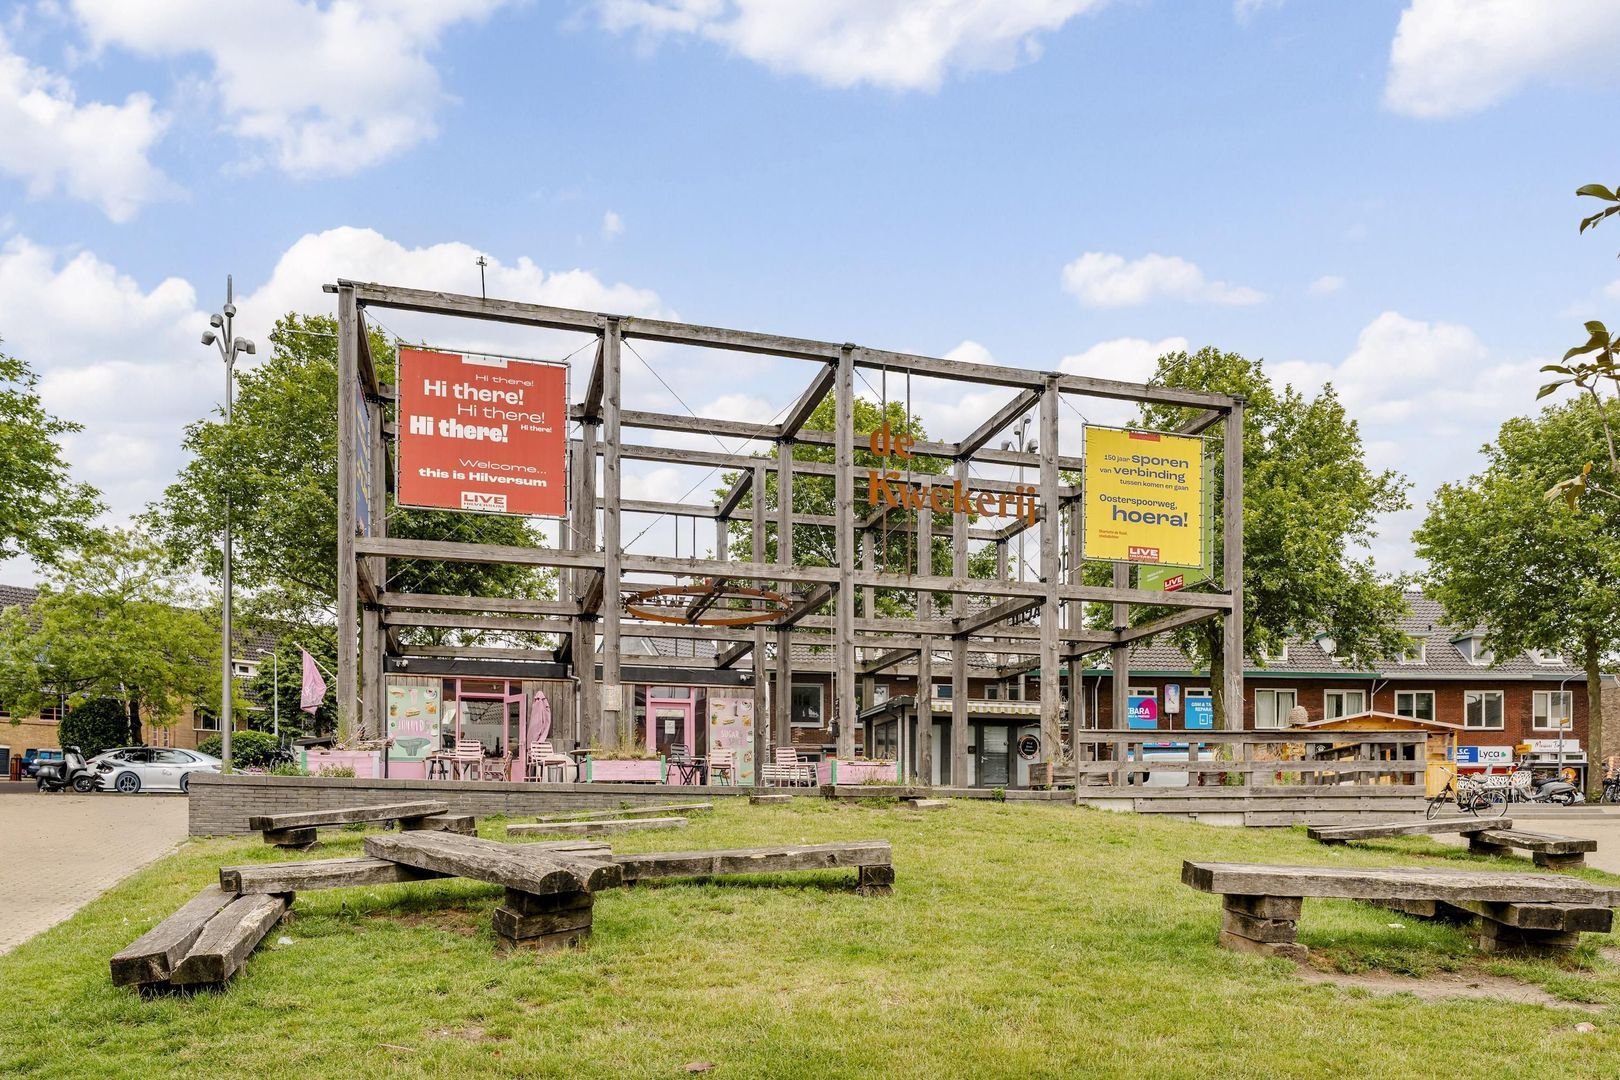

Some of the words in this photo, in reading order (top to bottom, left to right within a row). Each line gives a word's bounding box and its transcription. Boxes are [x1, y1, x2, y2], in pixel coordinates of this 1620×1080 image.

[475, 374, 489, 382] Hi
[492, 376, 534, 387] there!
[424, 379, 447, 398] Hi
[452, 382, 524, 405] there!
[457, 403, 477, 417] Hi
[482, 406, 545, 424] there!
[410, 415, 434, 436] Hi
[438, 418, 508, 443] there!
[529, 425, 552, 433] there!
[869, 421, 916, 459] de
[458, 458, 547, 475] Welcome...
[1116, 455, 1130, 463] jaar
[1131, 454, 1189, 469] sporen
[418, 467, 449, 479] this
[452, 470, 466, 480] is
[468, 471, 547, 488] Hilversum
[1113, 466, 1186, 483] verbinding
[1142, 481, 1164, 489] komen
[464, 494, 504, 505] LIVE
[867, 470, 1036, 527] Kwekerij
[1099, 493, 1178, 510] Oosterspoorweg,
[1112, 505, 1188, 528] hoera!
[1129, 547, 1158, 557] LIVE
[1164, 576, 1183, 587] LIVE
[1479, 750, 1500, 759] Lyca
